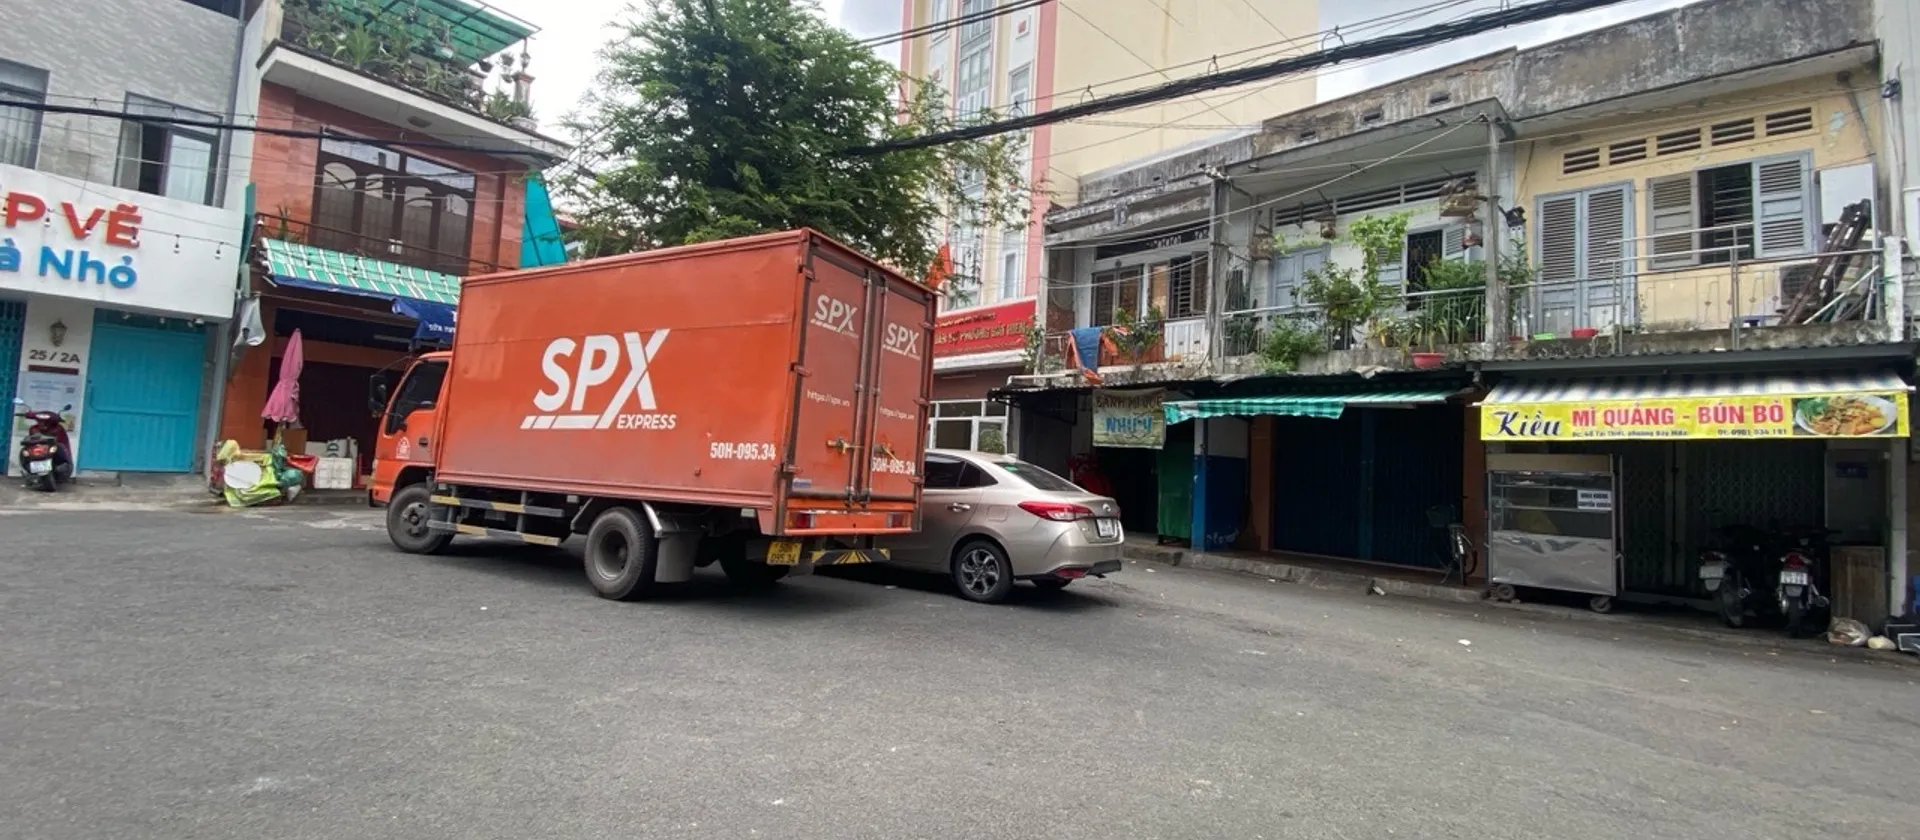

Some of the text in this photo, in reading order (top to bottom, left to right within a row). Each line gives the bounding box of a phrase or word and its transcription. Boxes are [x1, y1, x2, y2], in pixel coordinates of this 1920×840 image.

[60, 202, 142, 249] VẼ
[38, 245, 137, 288] Nhỏ
[814, 294, 857, 332] SPX
[885, 322, 919, 355] SPX
[29, 349, 80, 364] 25 / 2A
[533, 328, 670, 429] SPX
[616, 413, 677, 429] EXPRESS
[1493, 410, 1560, 436] Kiều
[1571, 406, 1596, 427] MÌ
[1603, 402, 1674, 426] QUẢNG
[1698, 401, 1744, 424] BÚN
[1752, 400, 1784, 423] BÒ
[710, 442, 776, 460] 50H-095.34
